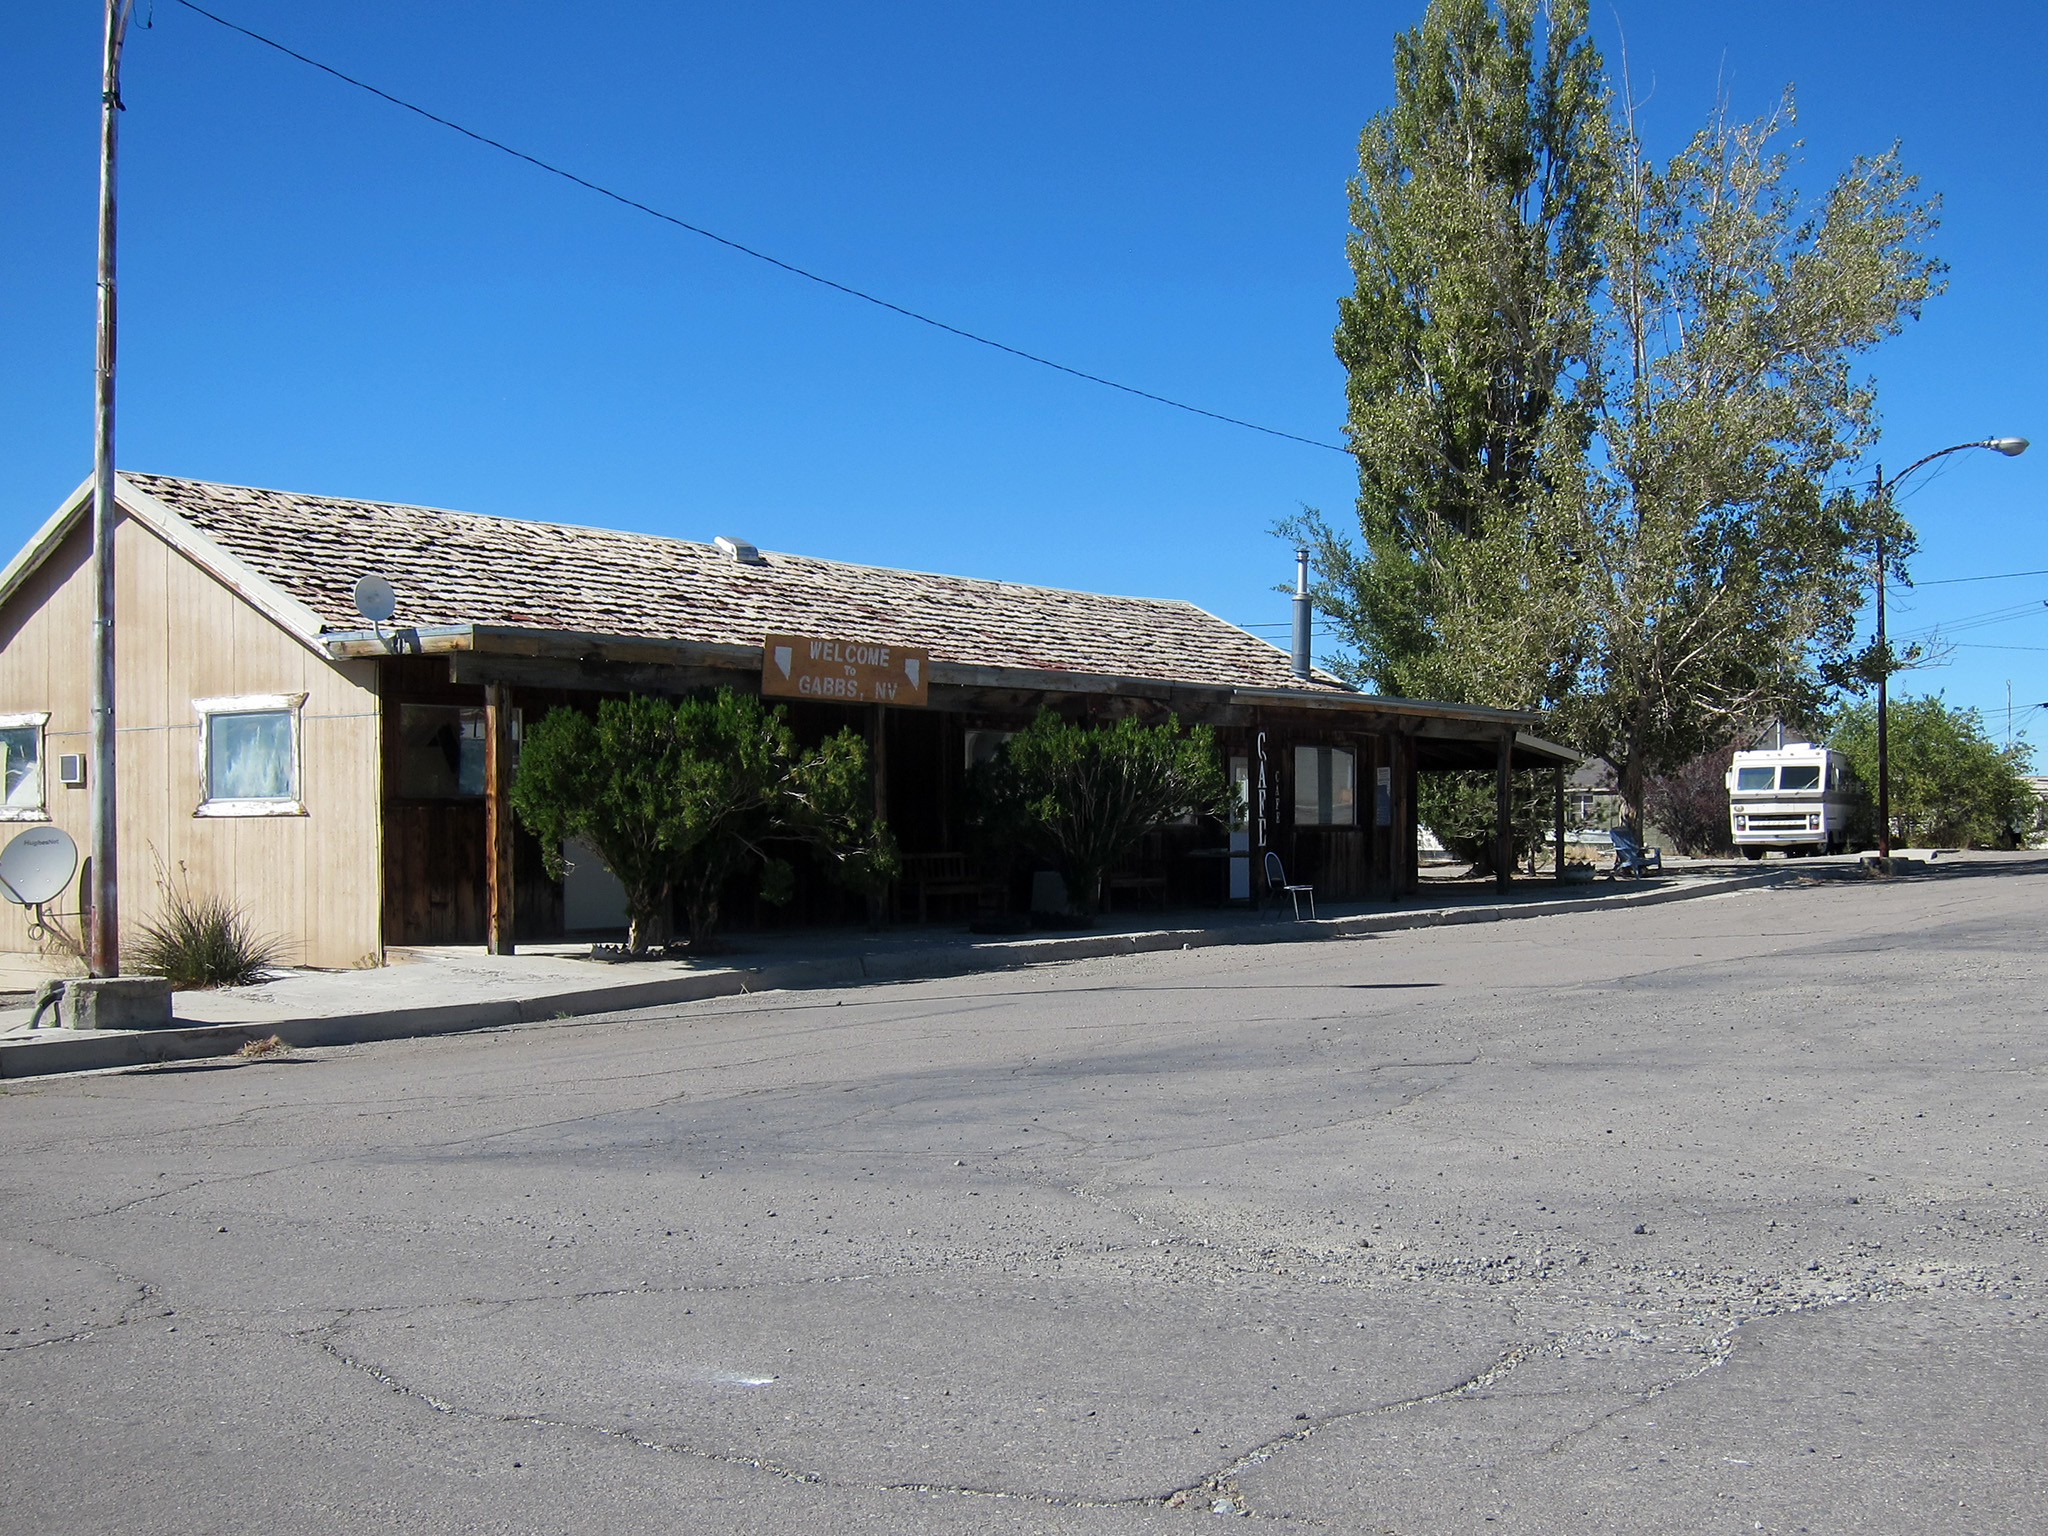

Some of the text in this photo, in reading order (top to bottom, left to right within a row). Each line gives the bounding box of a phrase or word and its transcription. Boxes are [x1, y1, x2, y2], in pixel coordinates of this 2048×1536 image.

[810, 641, 890, 667] WELCOME
[799, 675, 898, 700] GABBS, NV
[1257, 731, 1267, 846] CAFE
